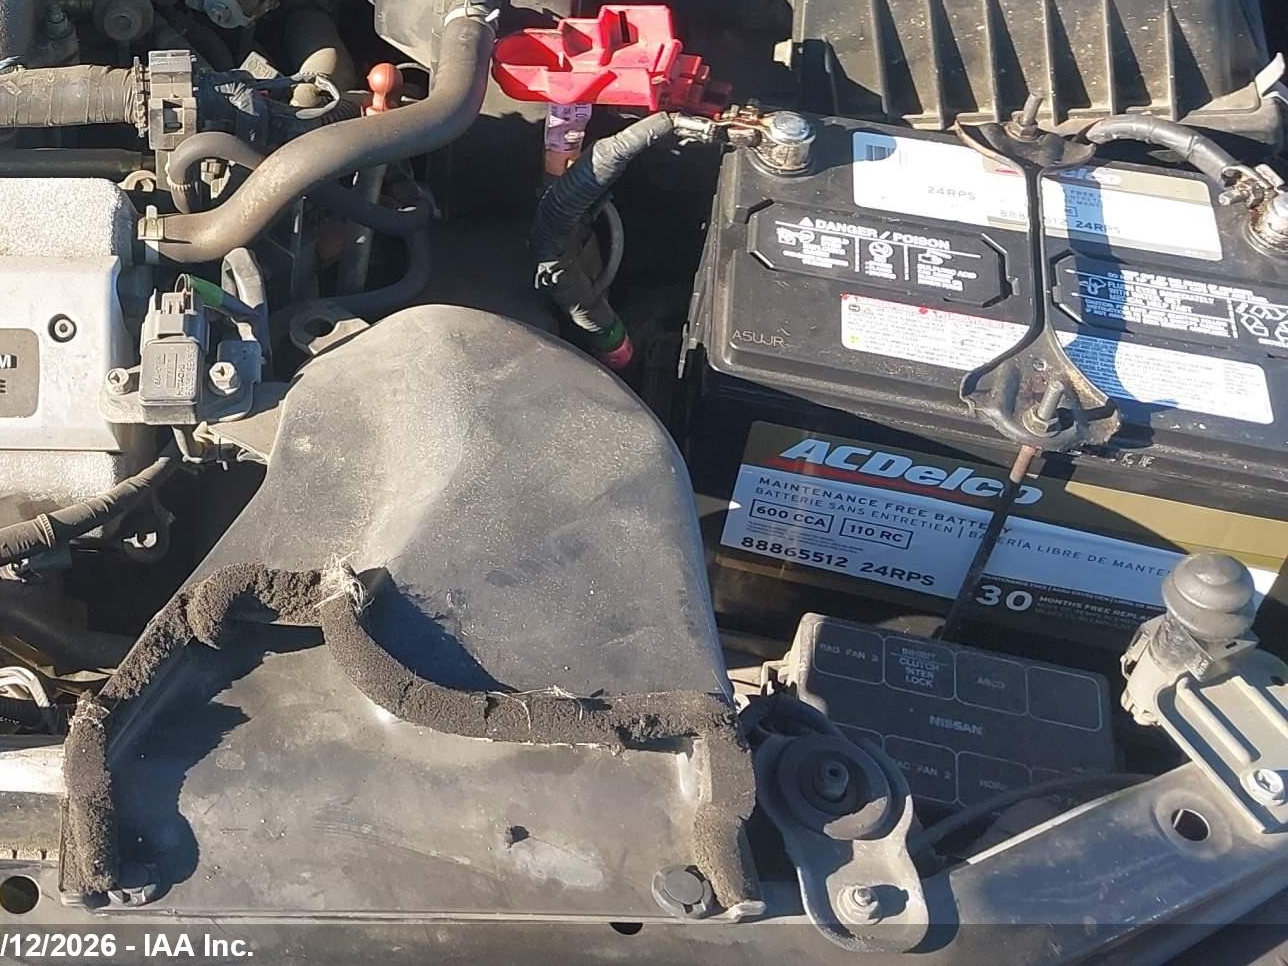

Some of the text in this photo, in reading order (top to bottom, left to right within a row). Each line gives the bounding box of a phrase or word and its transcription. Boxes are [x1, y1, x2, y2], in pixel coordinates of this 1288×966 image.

[815, 219, 878, 238] DANGER
[892, 232, 951, 251] POISON
[758, 477, 1013, 533] MAINTENANCE FREE BATTEY
[755, 486, 825, 509] BATTERIE
[828, 500, 865, 516] SANS
[871, 509, 953, 534] ENTRETIEN
[1037, 545, 1082, 560] LIBRE
[1088, 554, 1107, 565] DE
[1112, 559, 1171, 576] MANTE
[756, 505, 789, 520] 600
[793, 513, 826, 529] CCA
[849, 523, 875, 538] 110
[878, 529, 904, 544] RC
[741, 535, 849, 569] 88865512
[859, 560, 936, 587] 24RPS
[975, 584, 1033, 612] 30
[1039, 595, 1083, 610] MONTHS
[1084, 602, 1111, 615] FREE
[846, 648, 866, 660] FAN
[899, 656, 940, 671] CLUTCH
[905, 676, 934, 688] LOCK
[929, 715, 983, 735] NISSAN
